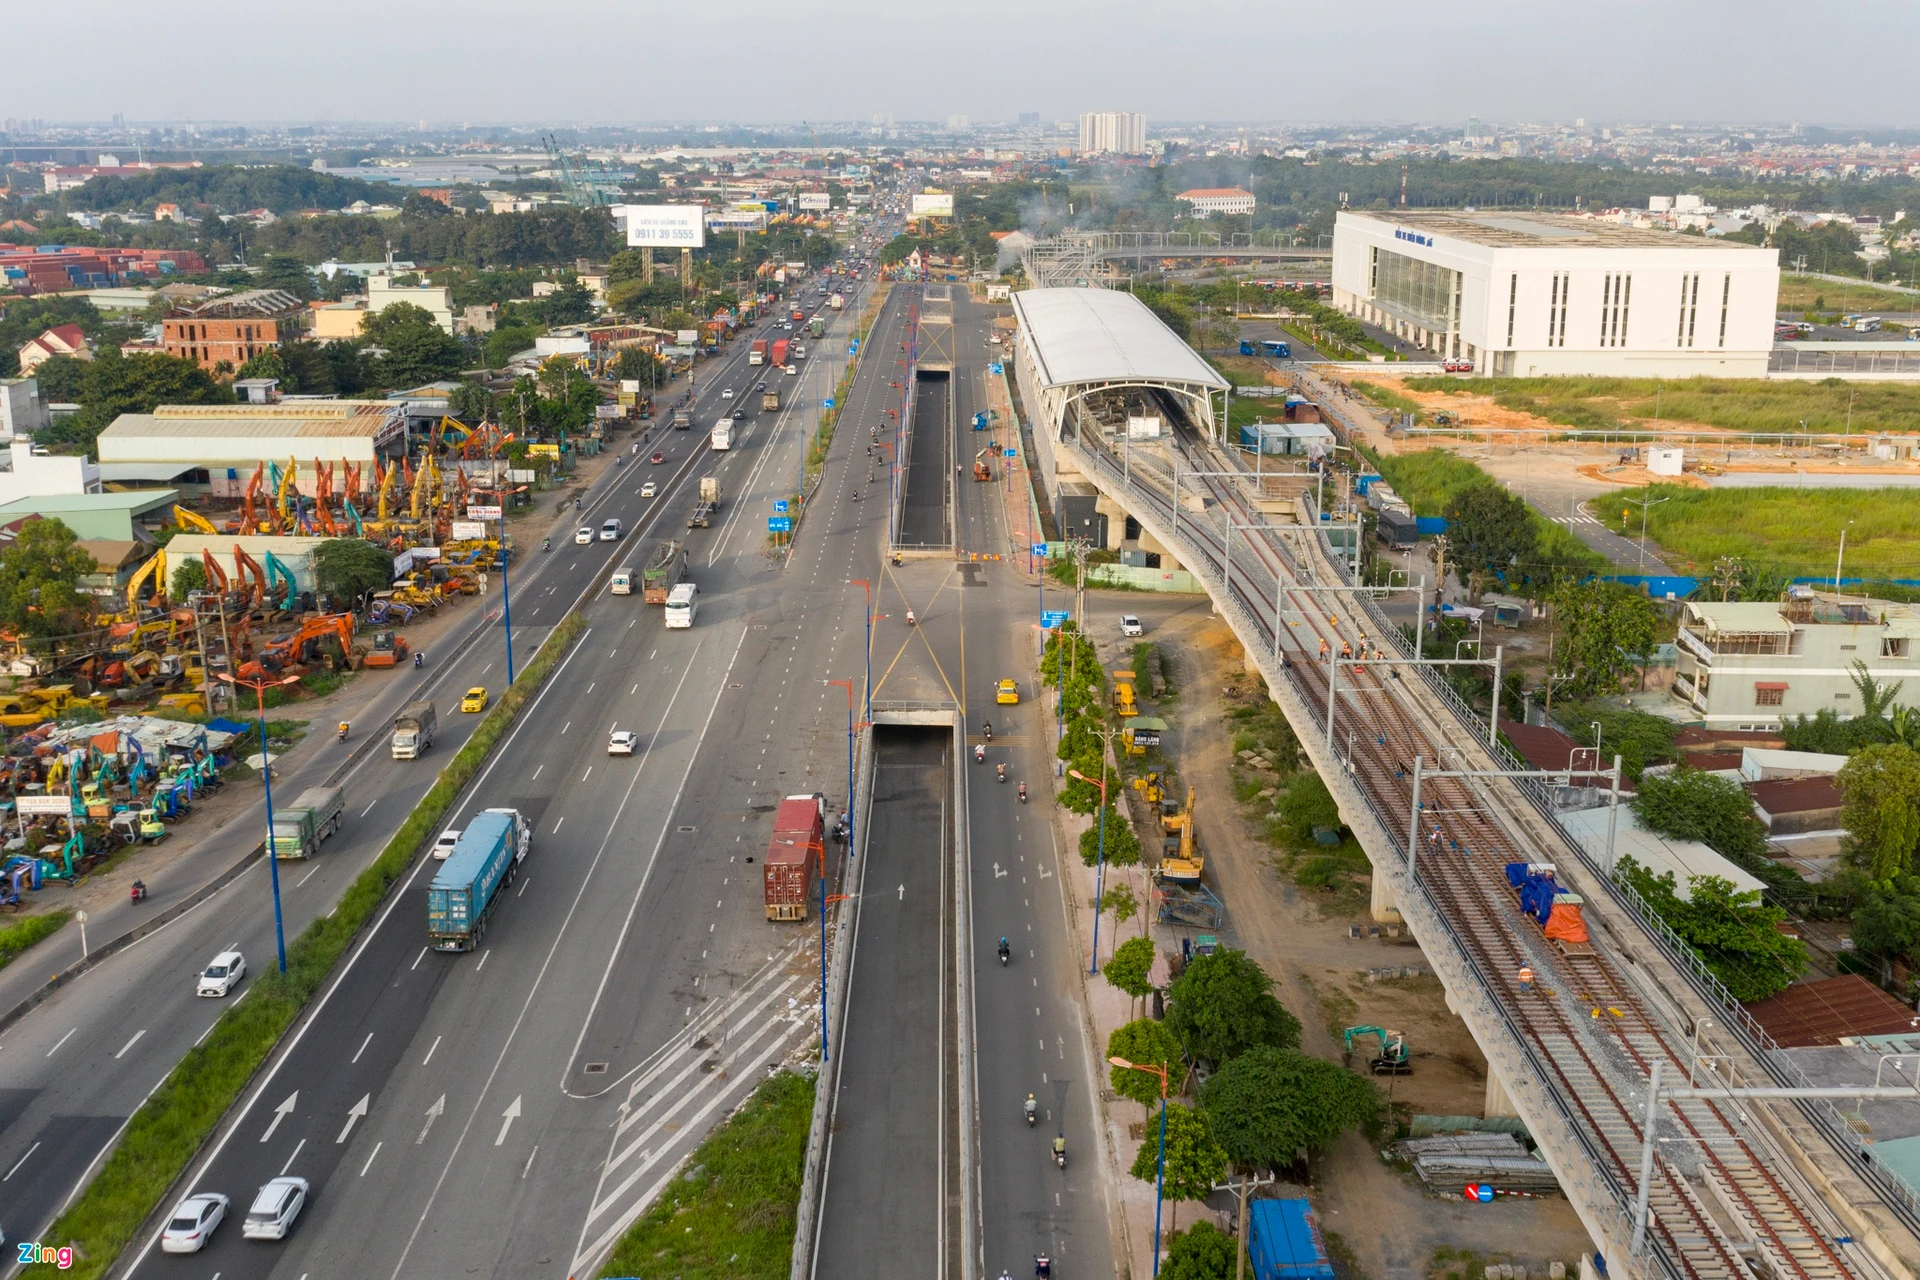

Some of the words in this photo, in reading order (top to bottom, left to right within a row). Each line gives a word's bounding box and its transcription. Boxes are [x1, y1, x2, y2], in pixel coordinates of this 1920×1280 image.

[635, 228, 656, 239] 0911
[659, 229, 670, 239] 39
[672, 229, 694, 239] 5555
